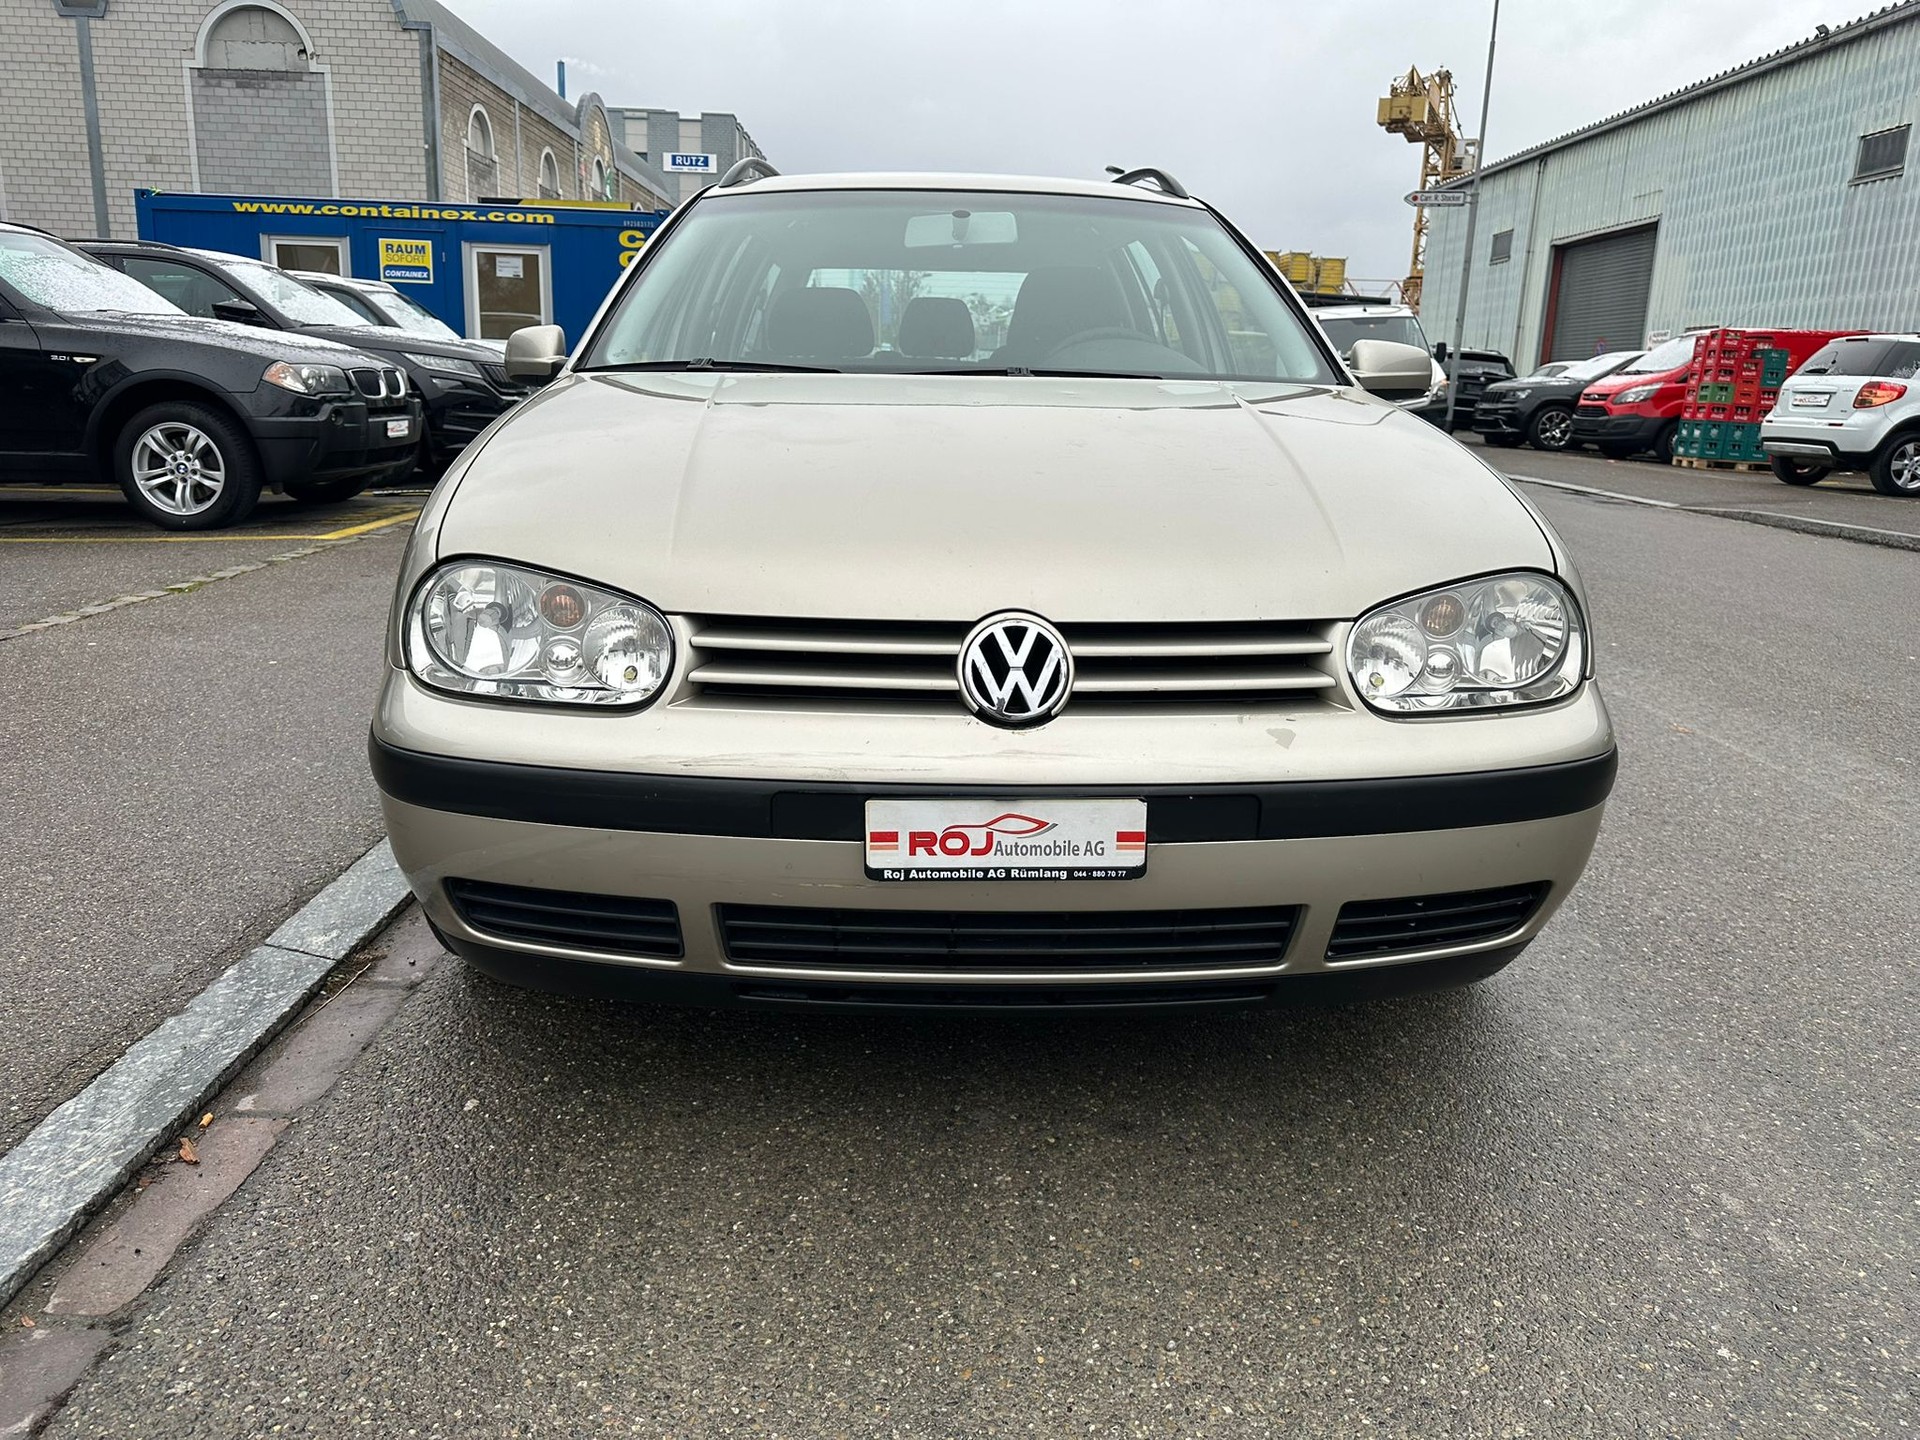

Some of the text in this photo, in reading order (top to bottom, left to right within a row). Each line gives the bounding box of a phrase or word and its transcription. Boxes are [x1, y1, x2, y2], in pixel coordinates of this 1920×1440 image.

[675, 155, 705, 166] RUTZ
[231, 201, 555, 224] www.containex.com
[385, 243, 427, 255] RAUM
[385, 254, 427, 264] SOFORT
[384, 269, 429, 279] CONTAINEX
[908, 831, 1105, 857] ROJ Automobile AG
[884, 868, 1068, 880] Roj Automobile AG Rümlang
[1073, 870, 1086, 878] 044
[1107, 870, 1116, 878] 70
[1117, 870, 1127, 878] 77
